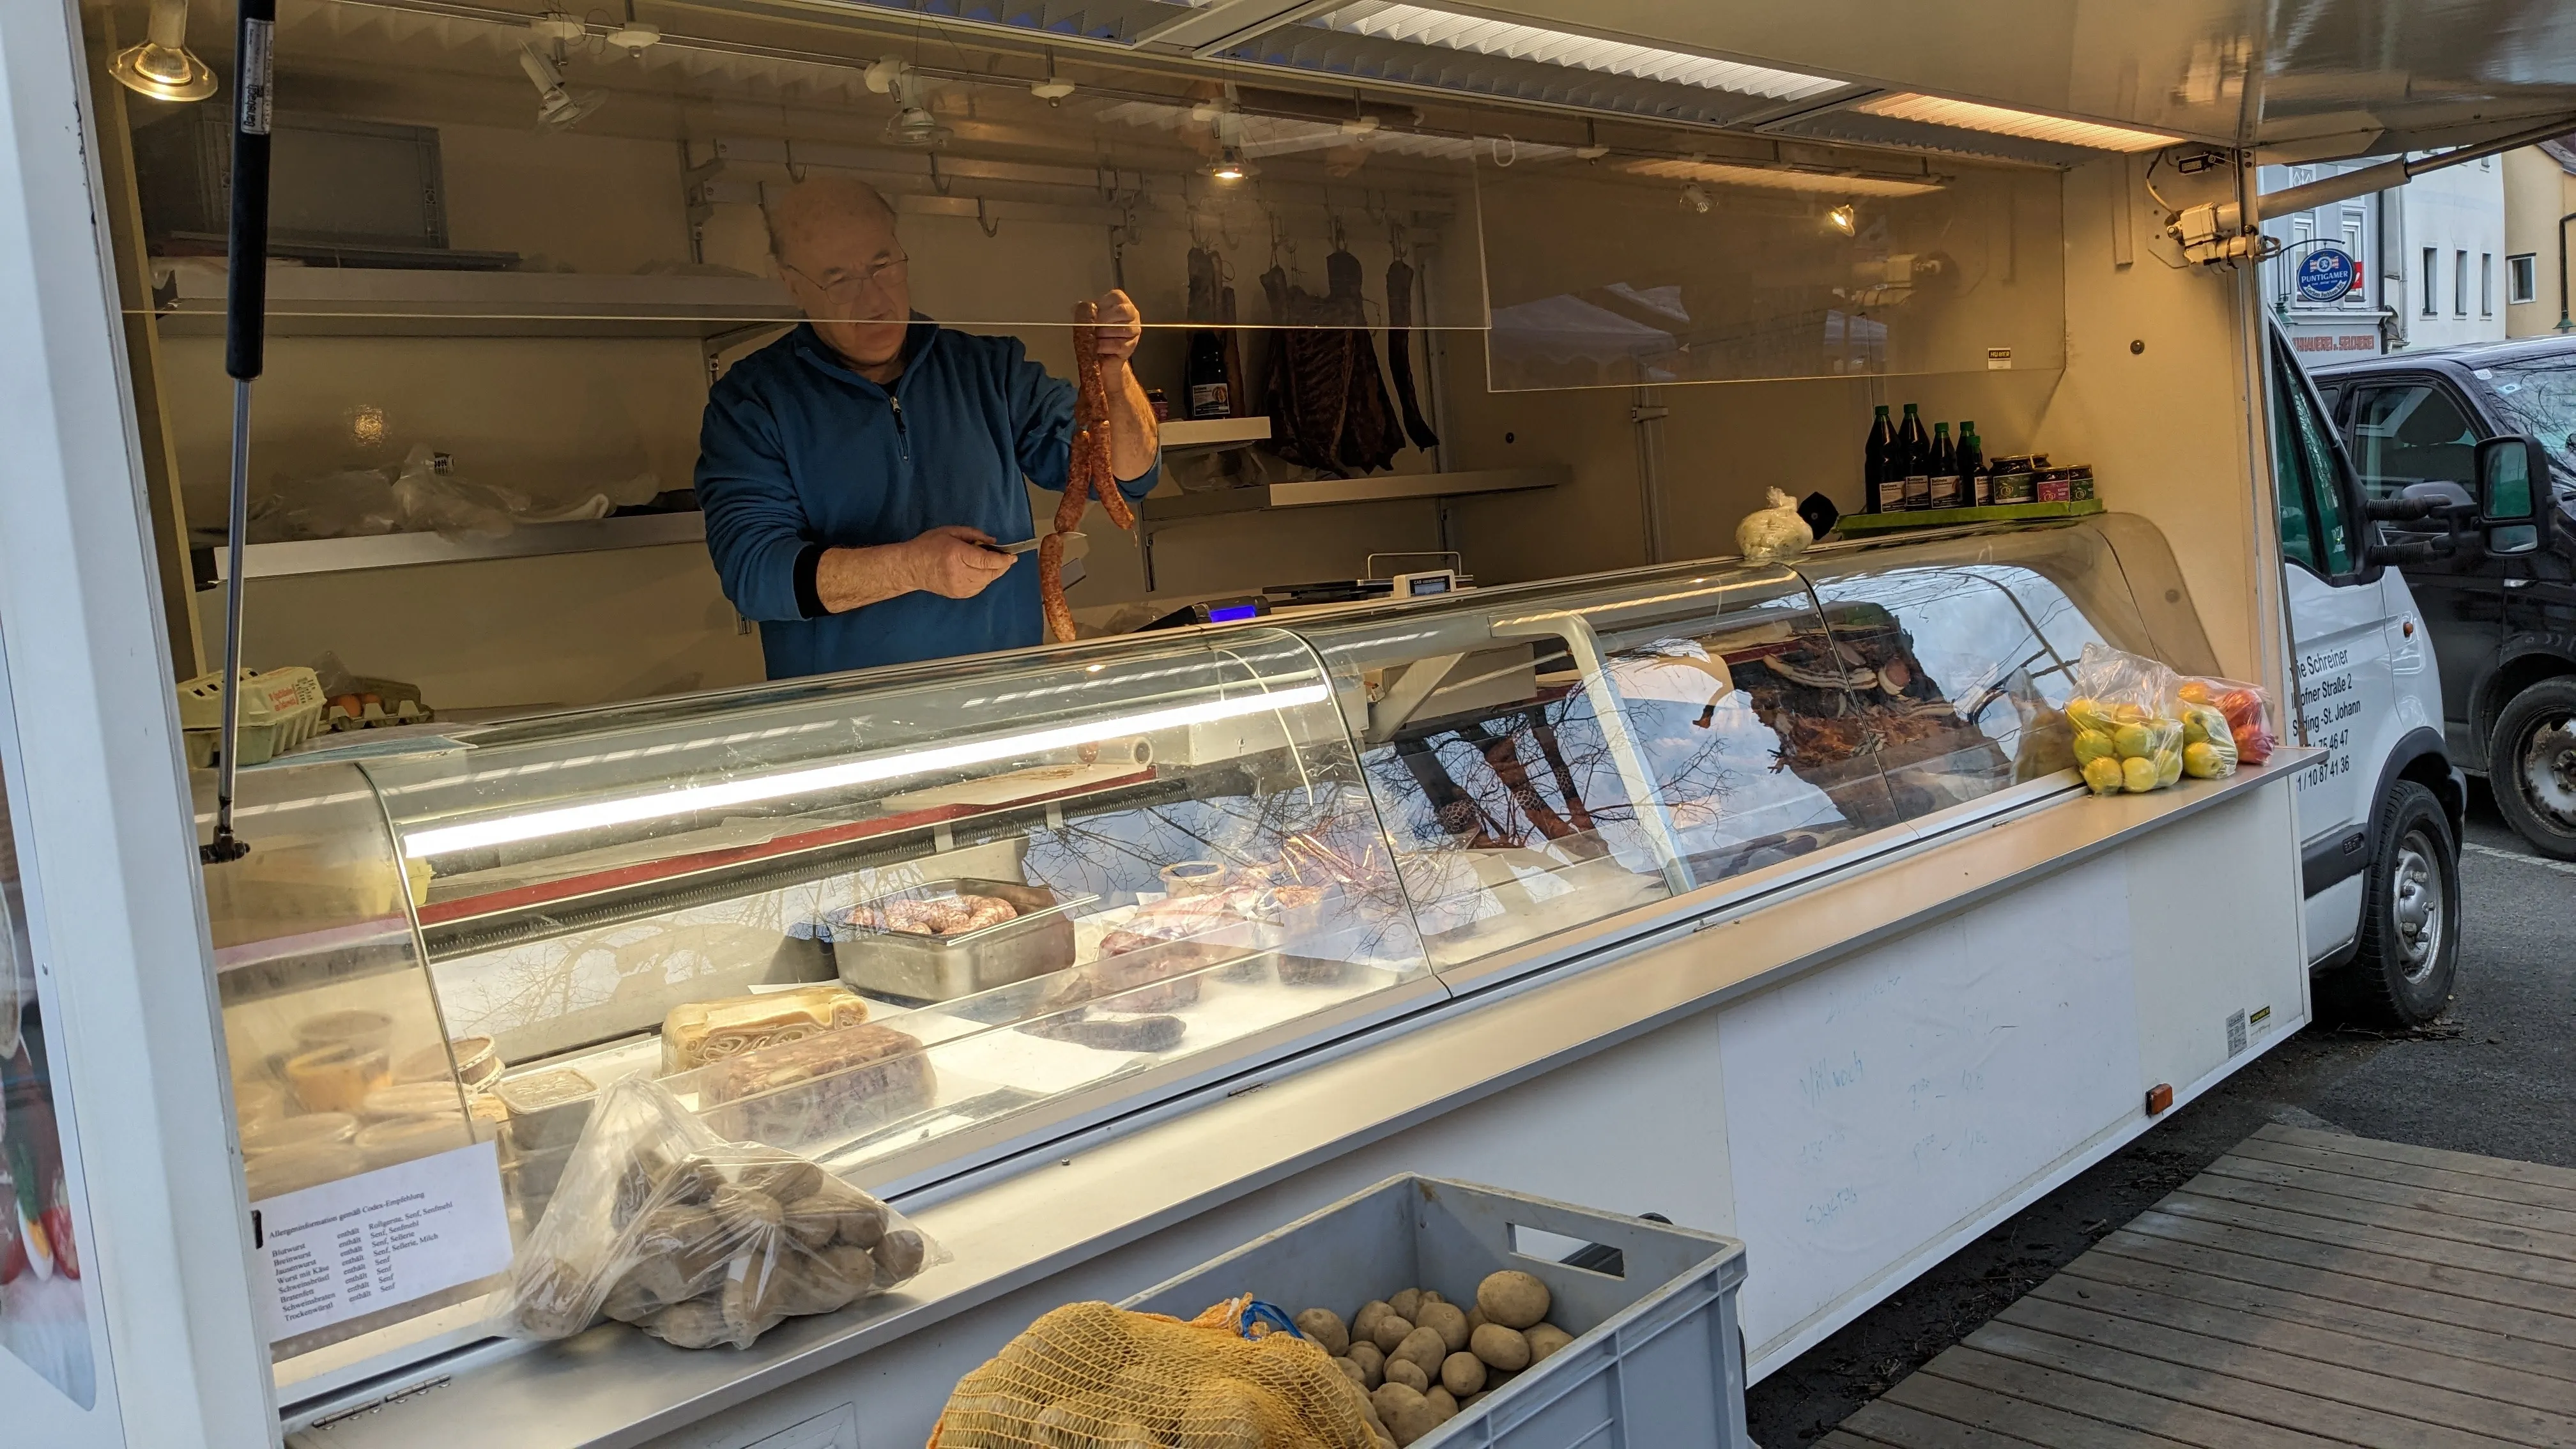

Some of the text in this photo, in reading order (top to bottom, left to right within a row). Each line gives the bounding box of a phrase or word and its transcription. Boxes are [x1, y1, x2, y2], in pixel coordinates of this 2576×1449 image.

[2301, 271, 2348, 283] PUNTIGAMER
[2307, 649, 2348, 675] Schreiner
[2322, 677, 2346, 698] Straße
[2347, 673, 2352, 689] 2
[2293, 715, 2320, 737] Sding
[2335, 700, 2361, 721] Johann
[2329, 733, 2338, 750] 46
[2340, 729, 2349, 746] 47
[2308, 769, 2317, 787] 10
[2319, 763, 2328, 782] 87
[2330, 760, 2338, 777] 41
[2341, 755, 2349, 773] 36
[270, 1192, 425, 1239] Allergeninformation gemäß Codex-Empfehlung
[272, 1243, 305, 1257] Blutwurst
[337, 1227, 360, 1239] enthält
[404, 1209, 422, 1220] Senf,
[423, 1201, 453, 1215] Senfmehl
[273, 1220, 419, 1266] Breinwurst enthält Senf, Senfmehl
[275, 1232, 415, 1276] Jausenwurst enthält Senf, Sellerie
[277, 1275, 298, 1284] Wurst
[312, 1266, 329, 1275] Käse
[342, 1254, 364, 1266] enthält
[392, 1240, 418, 1252] Sellerie,
[420, 1233, 439, 1244] Milch
[278, 1255, 390, 1293] Schweinsbrüstl enthält Senf
[280, 1264, 392, 1303] Bratenfett enthält Senf
[282, 1273, 394, 1312] Schweinsbraten enthält Senf
[349, 1291, 372, 1302] enthält
[380, 1282, 395, 1292] Senf
